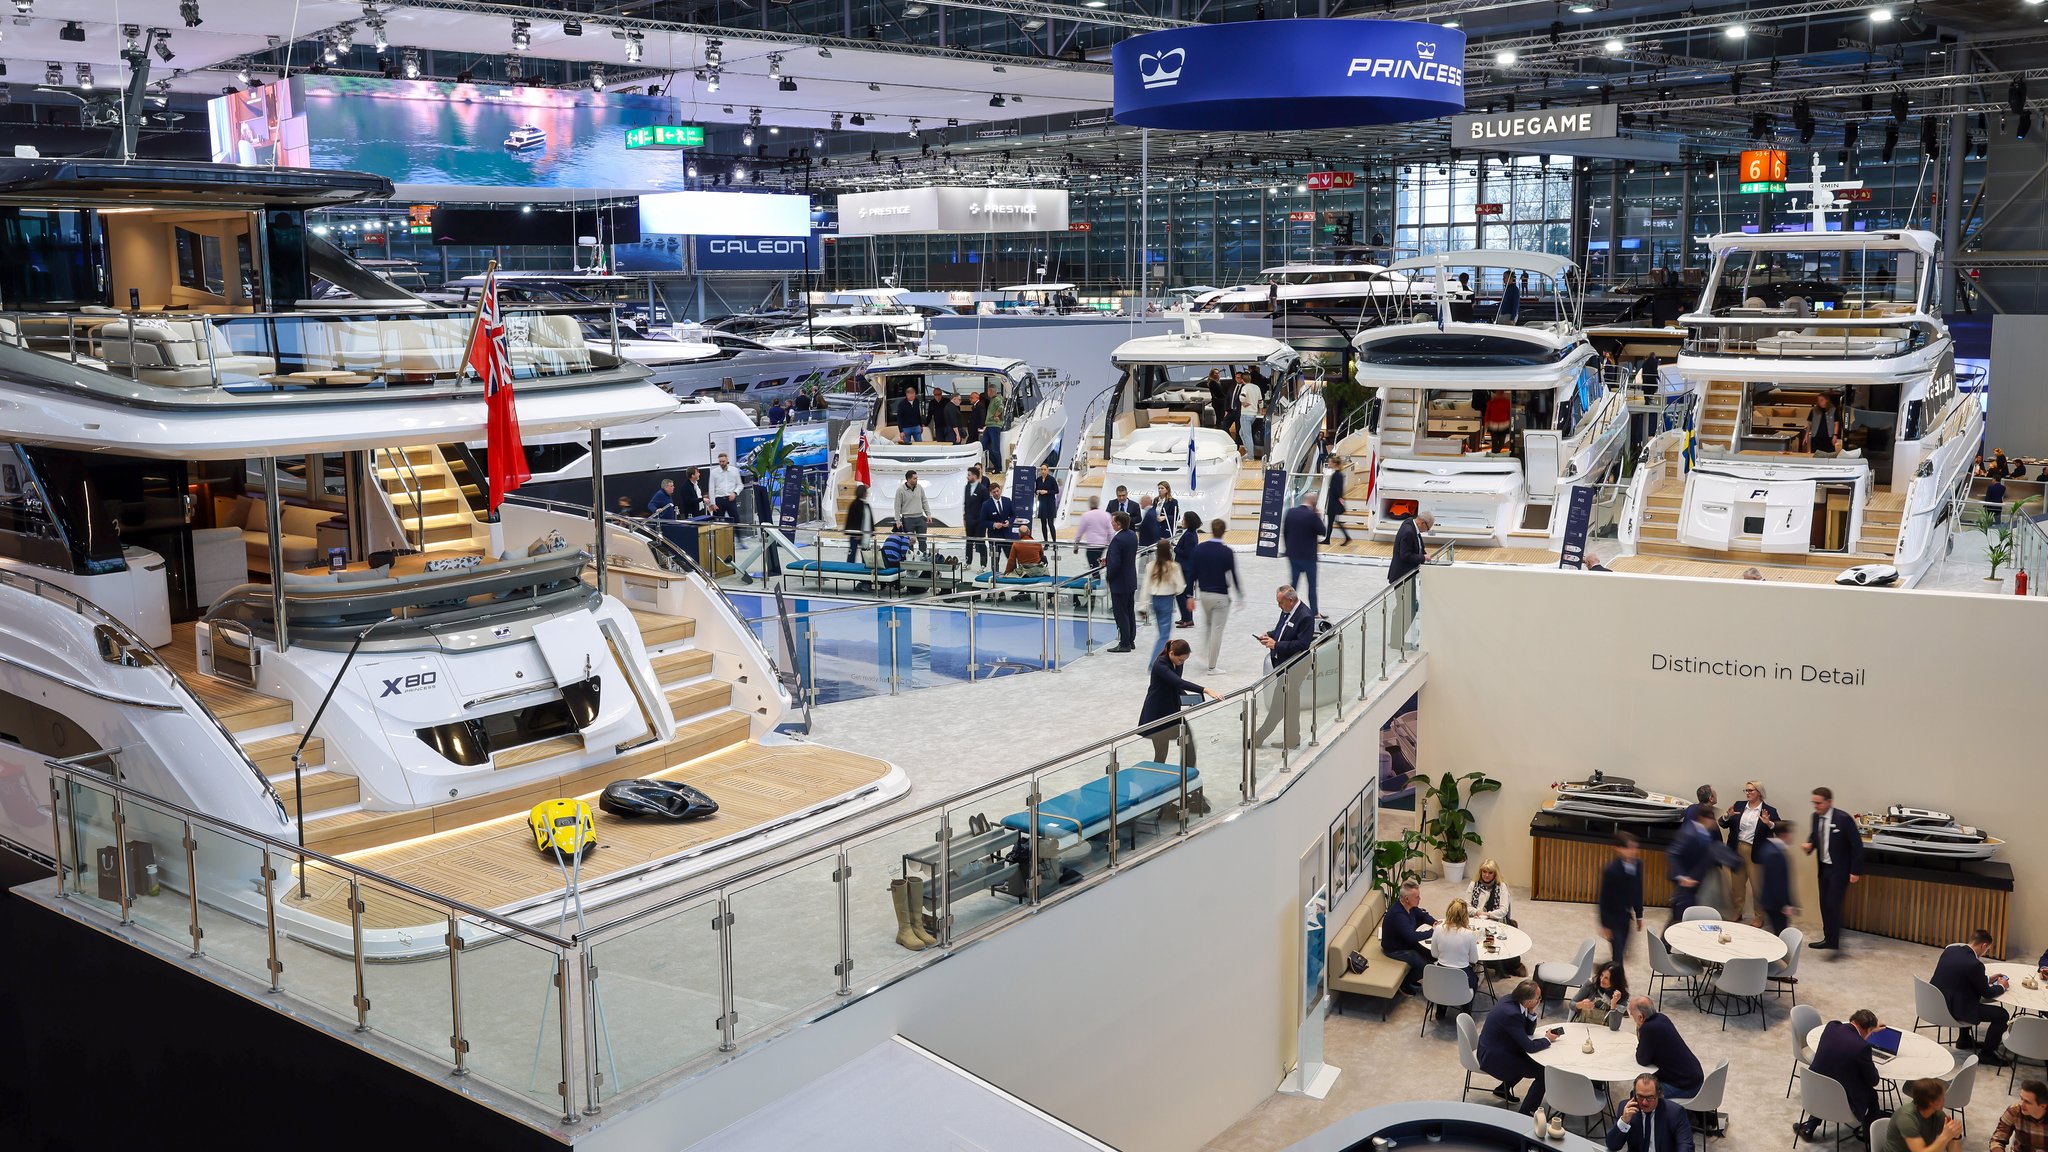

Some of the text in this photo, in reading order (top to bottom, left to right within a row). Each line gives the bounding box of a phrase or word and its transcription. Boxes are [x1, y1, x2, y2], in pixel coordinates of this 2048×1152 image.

[1347, 57, 1462, 87] PRINCESS
[1471, 113, 1592, 139] BLUEGAME
[1749, 159, 1761, 180] 6
[1774, 159, 1781, 179] 6
[868, 204, 911, 217] PRESTIGE
[984, 203, 1037, 214] PRESTIGE
[710, 239, 806, 254] GALEON
[1651, 653, 1865, 686] Distinction in Detail
[380, 671, 436, 698] X80
[404, 684, 436, 693] PRINCESS
